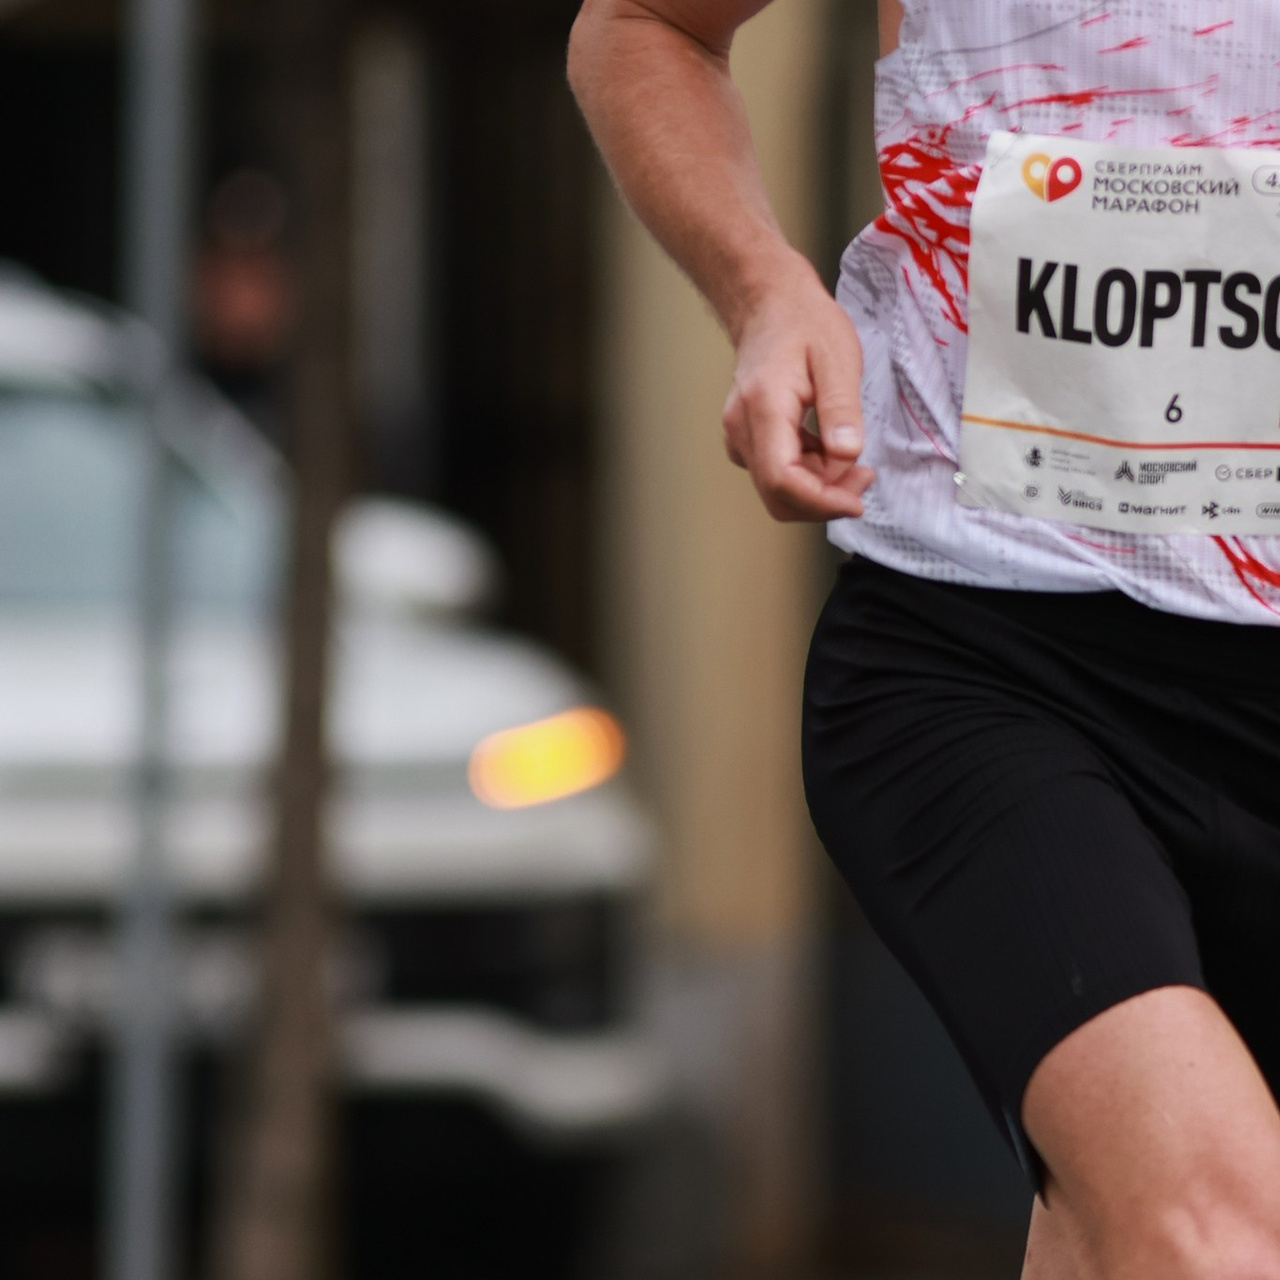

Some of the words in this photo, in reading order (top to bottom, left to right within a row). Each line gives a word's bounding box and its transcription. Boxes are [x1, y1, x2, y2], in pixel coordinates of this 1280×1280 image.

[1094, 159, 1203, 175] СБЕРПРАЙМ
[1092, 177, 1240, 197] МОСКОВСКИЙ
[1091, 195, 1200, 214] МАРАФОН
[1164, 393, 1183, 423] 6
